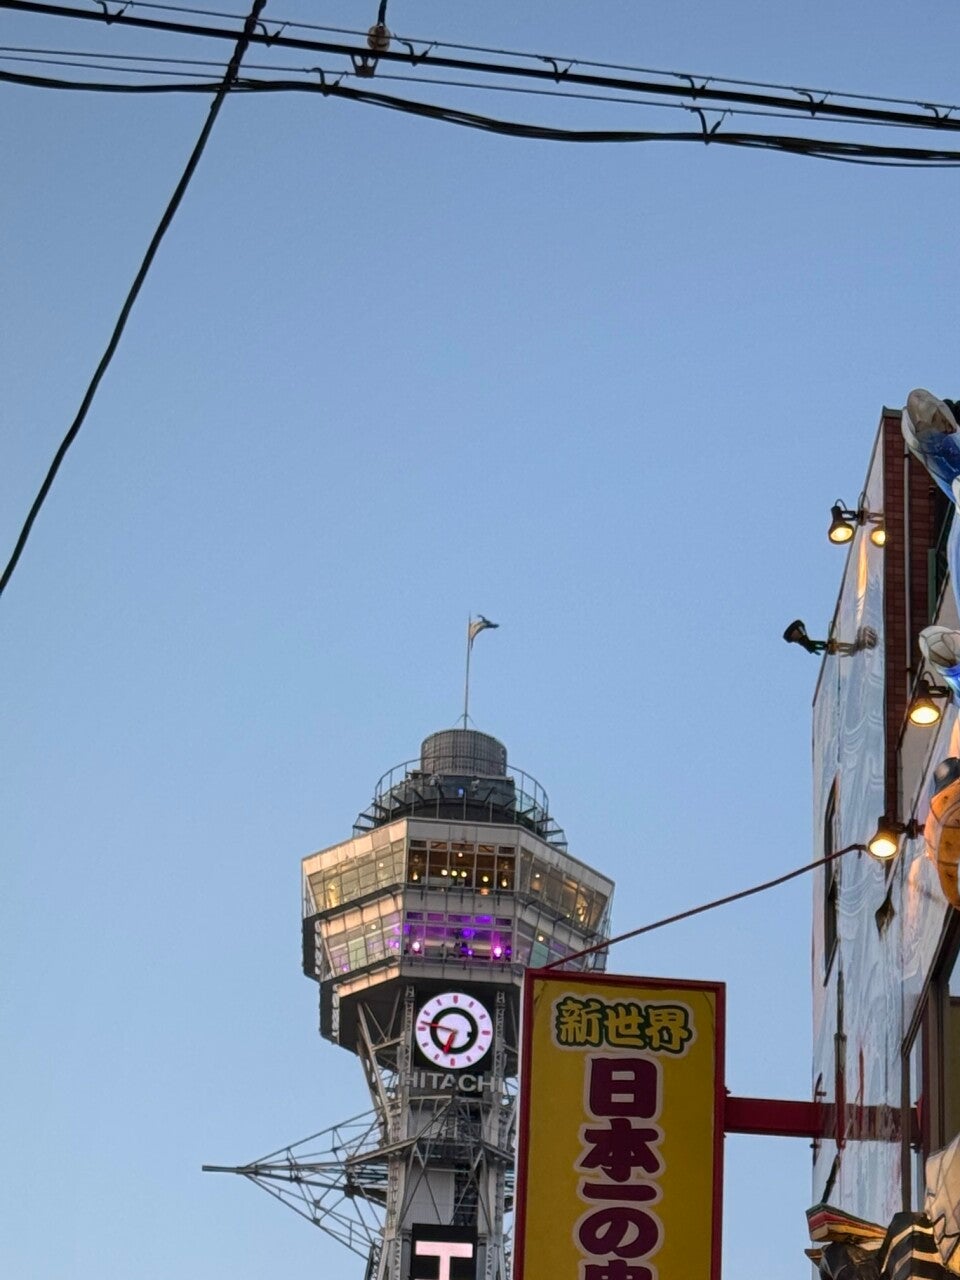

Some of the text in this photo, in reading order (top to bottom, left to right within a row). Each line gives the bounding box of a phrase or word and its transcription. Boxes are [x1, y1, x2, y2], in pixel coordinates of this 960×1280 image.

[557, 998, 692, 1052] 新世界
[401, 1072, 503, 1092] HITACHI
